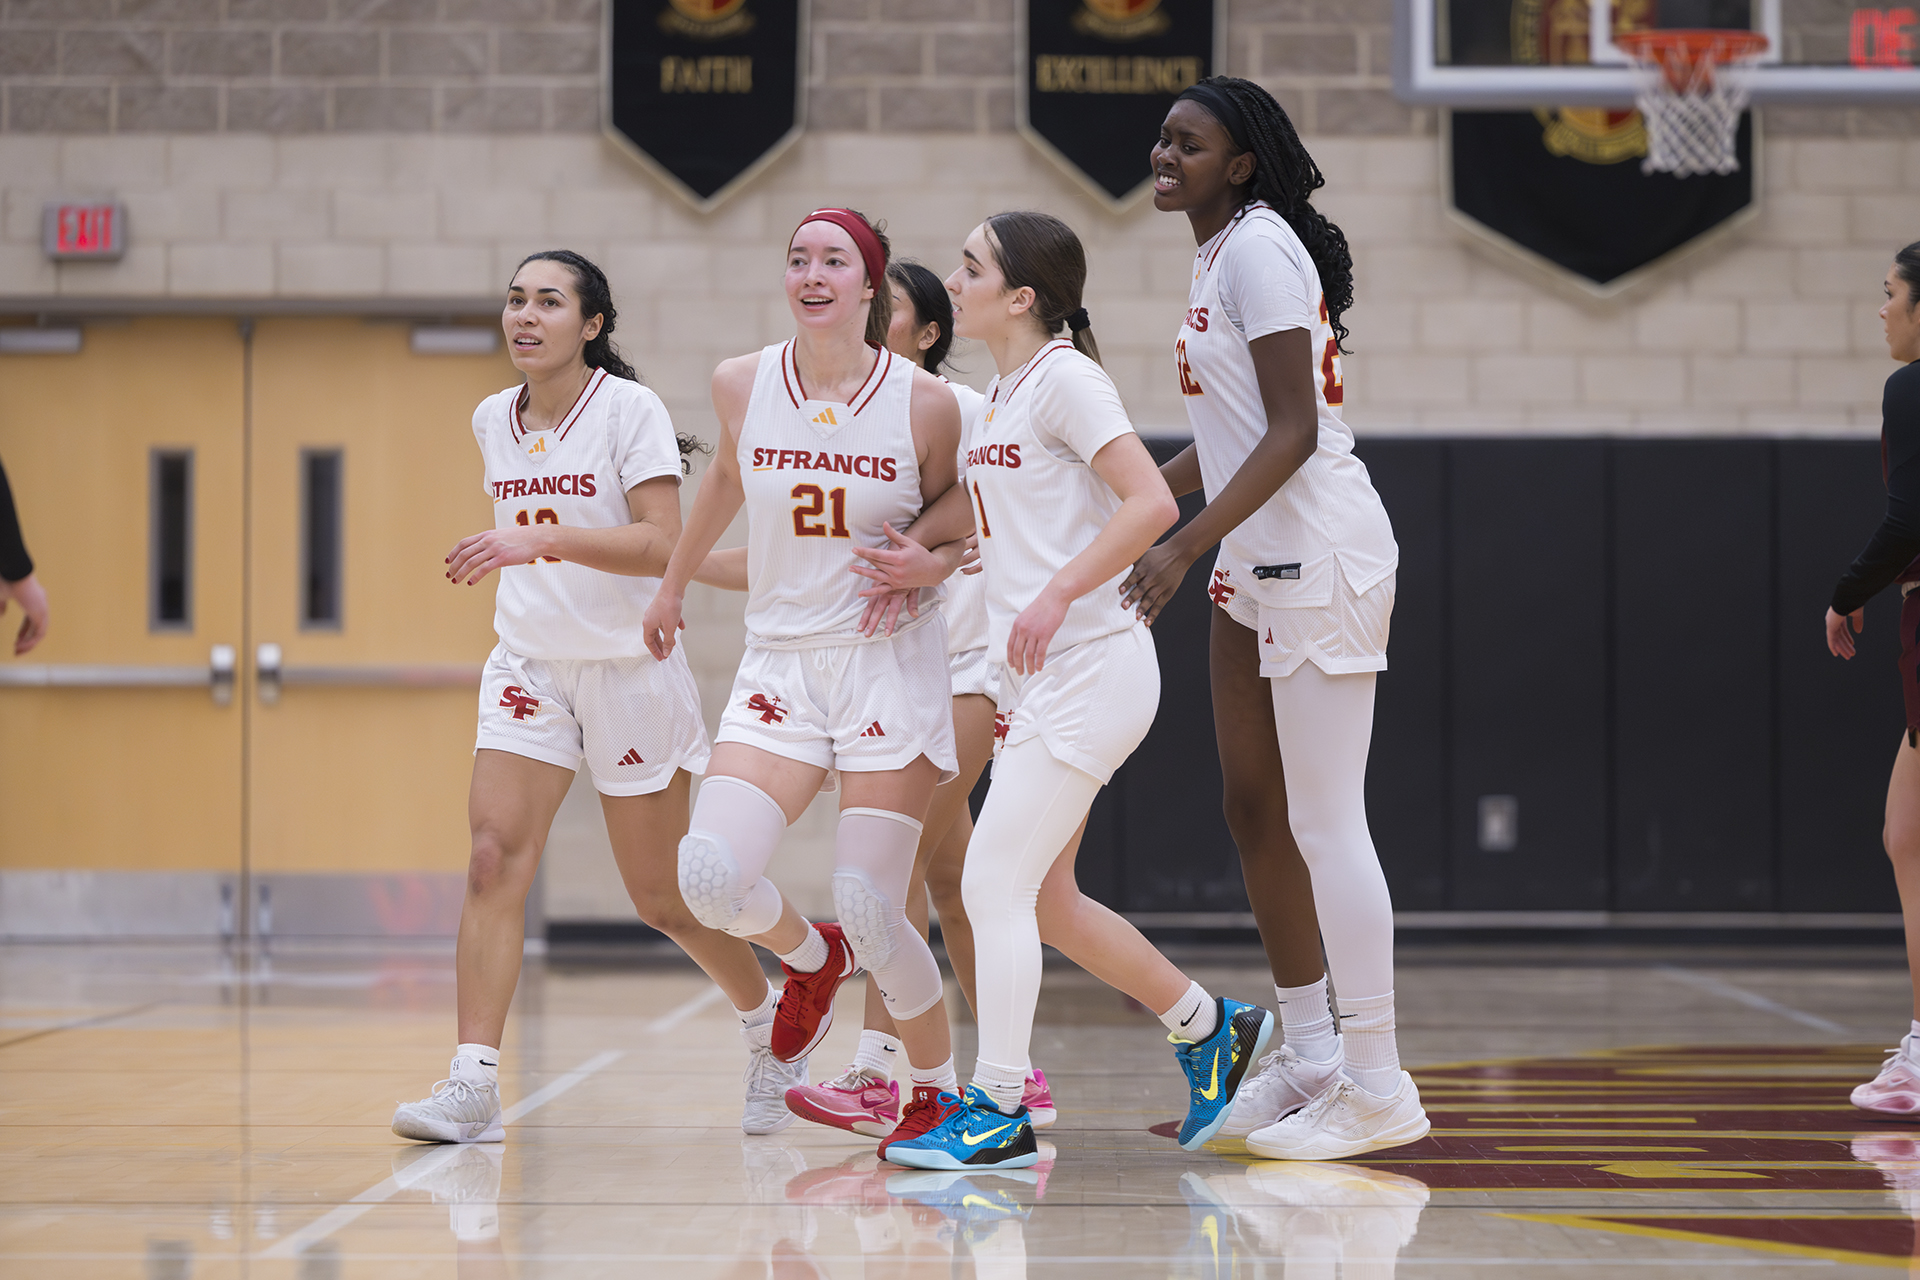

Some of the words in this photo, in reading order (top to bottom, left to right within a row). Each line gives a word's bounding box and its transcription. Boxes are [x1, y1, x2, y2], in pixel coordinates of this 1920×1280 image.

[660, 55, 752, 93] FAITH
[1036, 55, 1203, 94] EXCELLENCE
[57, 205, 114, 253] EXIT
[791, 483, 851, 539] 21
[498, 684, 541, 722] SF
[746, 693, 789, 725] SF
